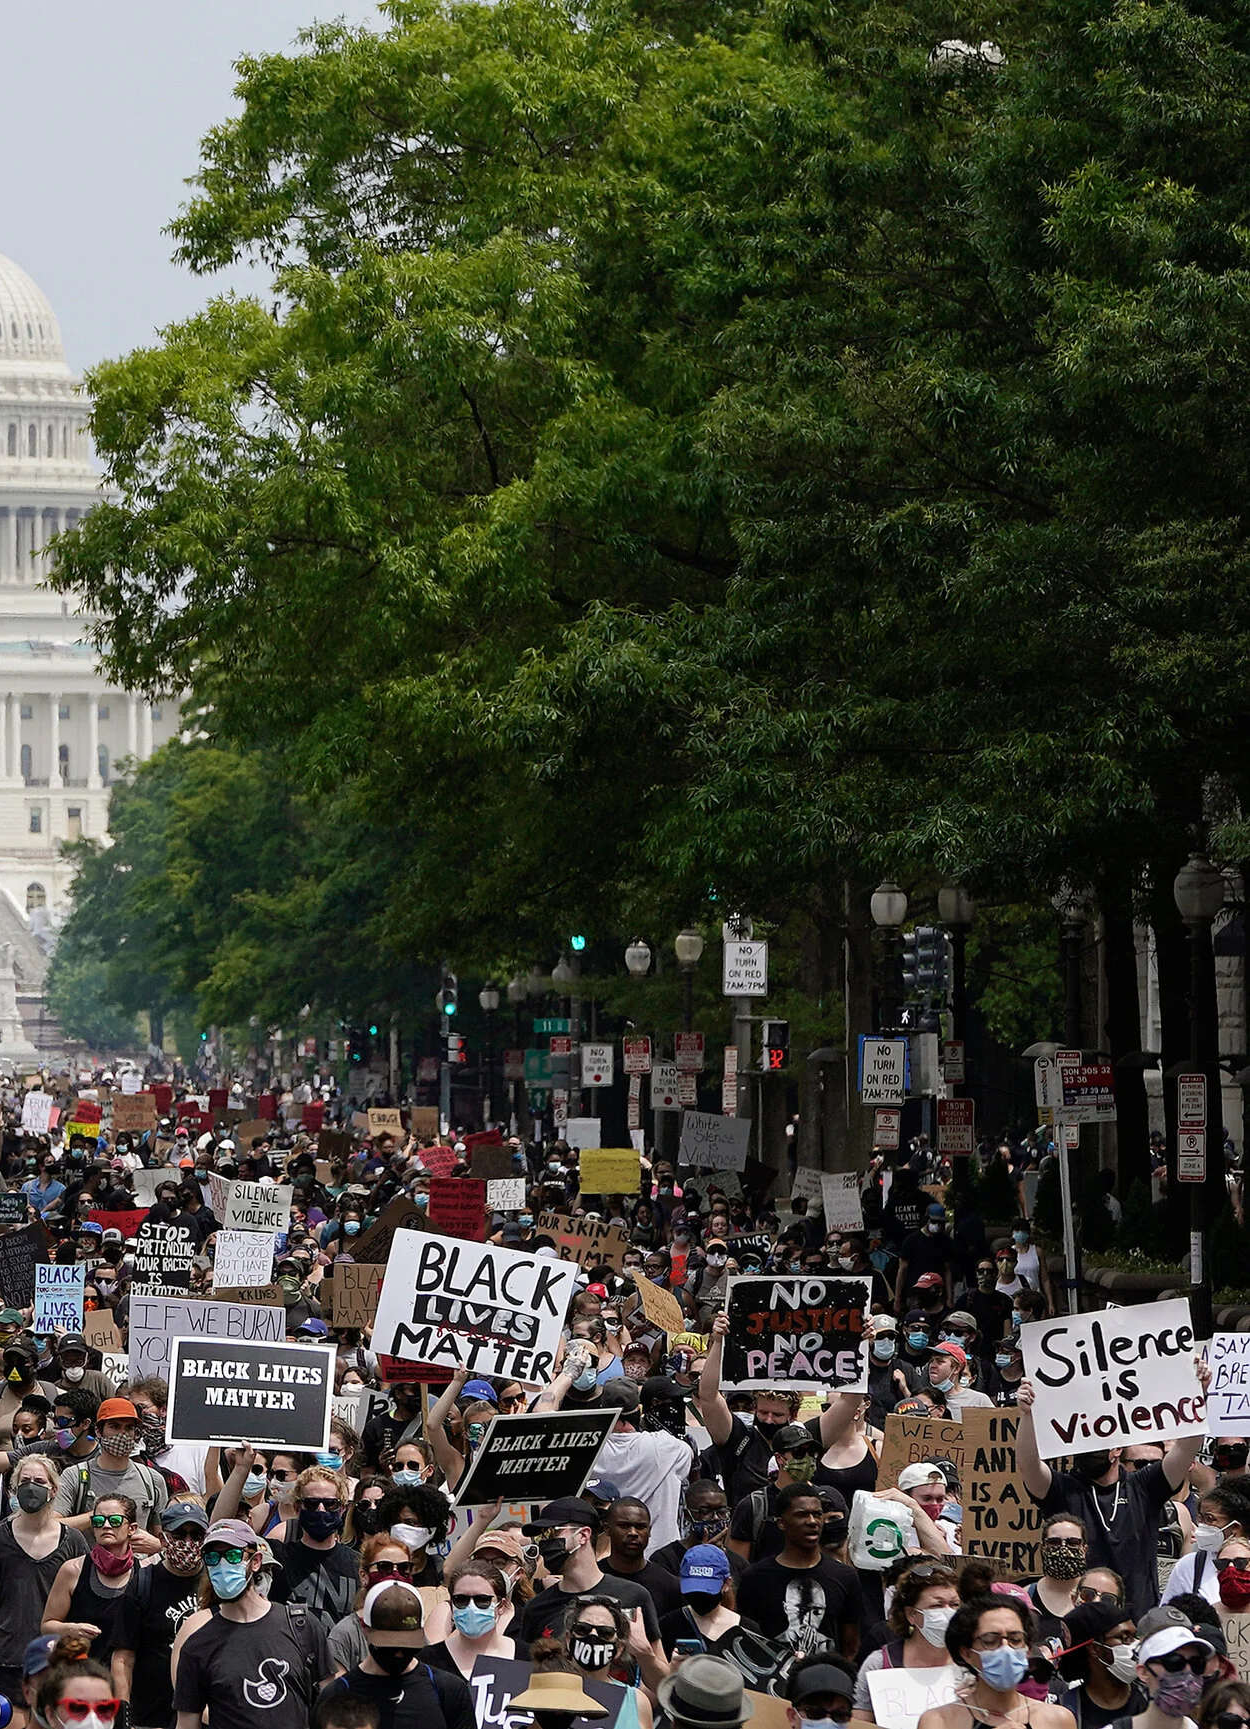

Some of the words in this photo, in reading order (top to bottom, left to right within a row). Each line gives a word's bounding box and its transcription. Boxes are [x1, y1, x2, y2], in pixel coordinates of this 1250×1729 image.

[877, 1046, 891, 1056] NO
[660, 1068, 676, 1076] NO
[873, 1060, 895, 1070] TURN
[866, 1075, 878, 1084] ON
[882, 1074, 899, 1084] RED
[946, 1102, 966, 1110] SNOW
[686, 1115, 720, 1130] White
[694, 1130, 735, 1144] Silence
[682, 1144, 738, 1166] Violence
[235, 1184, 280, 1204] SILENCE
[488, 1181, 522, 1190] BLACK
[489, 1190, 518, 1200] LIVES
[488, 1200, 526, 1210] MATTER
[232, 1210, 283, 1228] VIOLENCE
[140, 1222, 190, 1242] STOP
[218, 1232, 245, 1246] YEAH,
[252, 1234, 272, 1246] SEX
[538, 1217, 559, 1230] OUR
[564, 1221, 610, 1239] SKIN
[618, 1230, 630, 1242] IS
[136, 1238, 196, 1258] PRETENDING
[218, 1246, 232, 1258] IS
[560, 1248, 614, 1265] RIME
[134, 1256, 160, 1272] YOUR
[162, 1257, 194, 1272] RACISM
[216, 1259, 238, 1271] BUT
[242, 1259, 268, 1272] HAVE
[38, 1267, 81, 1284] BLACK
[148, 1272, 162, 1285] IS
[216, 1274, 234, 1286] YOU
[237, 1274, 266, 1286] EVER
[344, 1265, 382, 1290] BLA
[415, 1241, 566, 1317] BLACK
[255, 1289, 276, 1300] LIVES
[339, 1291, 378, 1309] LIV
[769, 1280, 826, 1311] NO
[44, 1302, 76, 1316] LIVES
[134, 1304, 182, 1332] IF
[186, 1307, 218, 1334] WE
[336, 1309, 376, 1327] MAT
[426, 1296, 534, 1342] LIVES
[36, 1317, 80, 1334] MATTER
[746, 1308, 864, 1334] JUSTICE
[390, 1322, 553, 1384] MATTER
[774, 1333, 823, 1354] NO
[1035, 1320, 1194, 1387] Silence
[1214, 1336, 1250, 1360] SAY
[182, 1358, 250, 1381] BLACK
[258, 1362, 323, 1386] LIVES
[748, 1350, 859, 1380] PEACE
[1101, 1368, 1139, 1401] is
[204, 1387, 296, 1412] MATTER
[488, 1435, 546, 1454] BLACK
[547, 1430, 602, 1448] LIVES
[902, 1420, 932, 1439] WE
[940, 1426, 964, 1444] CA
[496, 1455, 570, 1476] MATTER
[972, 1482, 992, 1504] IS
[999, 1484, 1020, 1504] A
[969, 1506, 998, 1532] TO
[1008, 1508, 1043, 1531] JU
[165, 1593, 200, 1621] Anti
[572, 1640, 614, 1664] VOTE
[883, 1686, 958, 1718] BLAC
